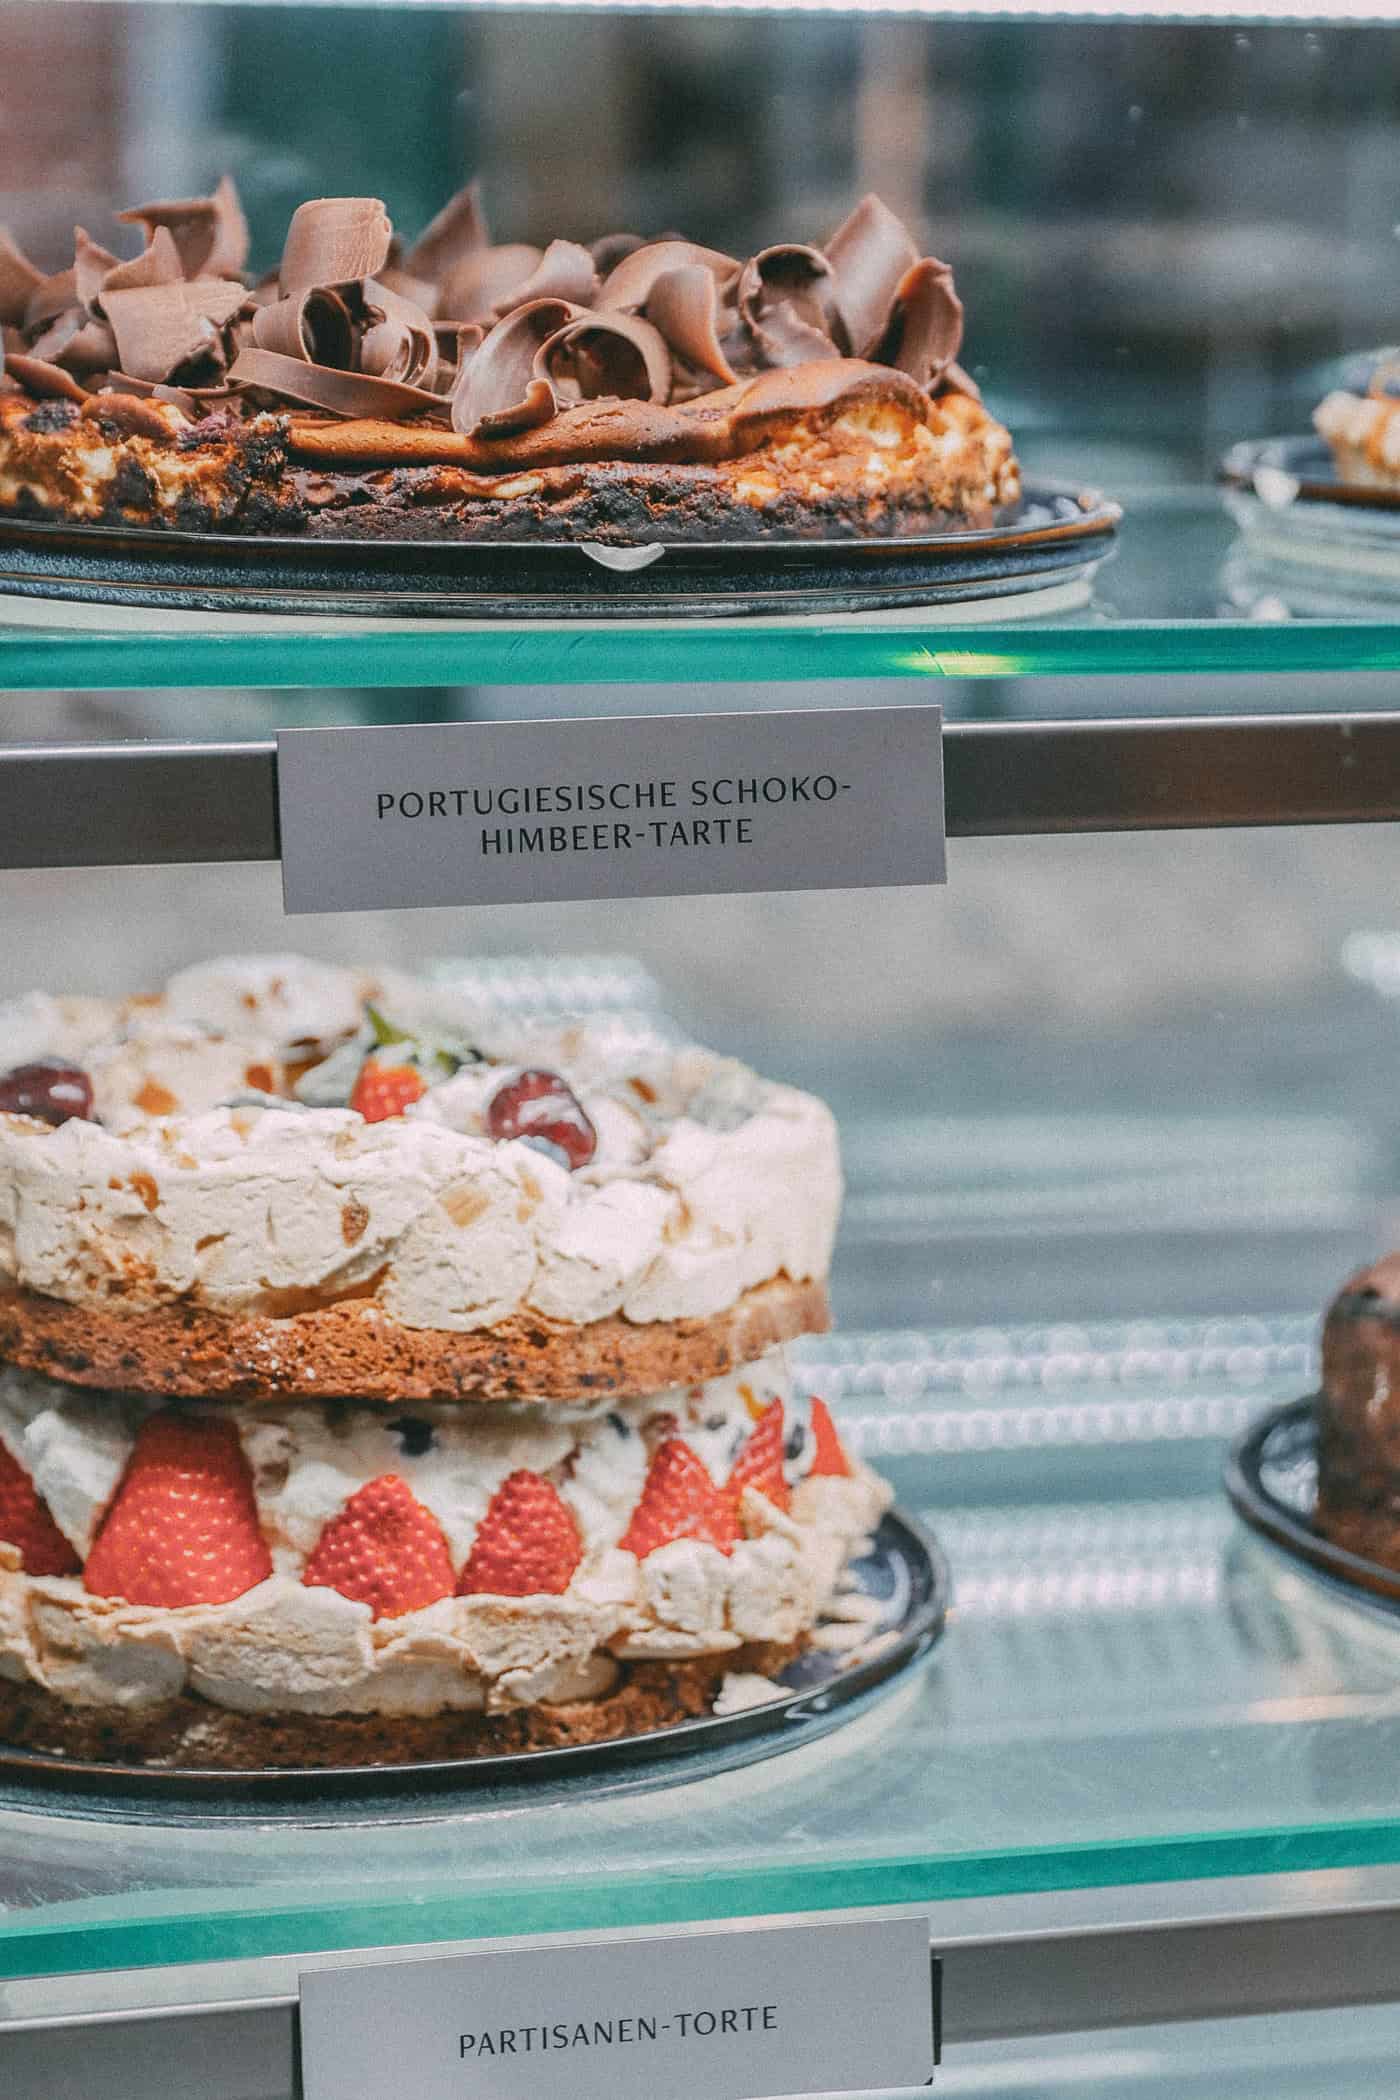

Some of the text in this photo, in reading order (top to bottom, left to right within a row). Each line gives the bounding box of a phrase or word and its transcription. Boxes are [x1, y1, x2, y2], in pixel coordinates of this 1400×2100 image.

[376, 775, 852, 820] PORTUGIESISCHE SCHOKO-
[481, 818, 754, 855] HIMBEER-TARTE
[459, 2005, 778, 2059] PARTISANEN-TORTE
